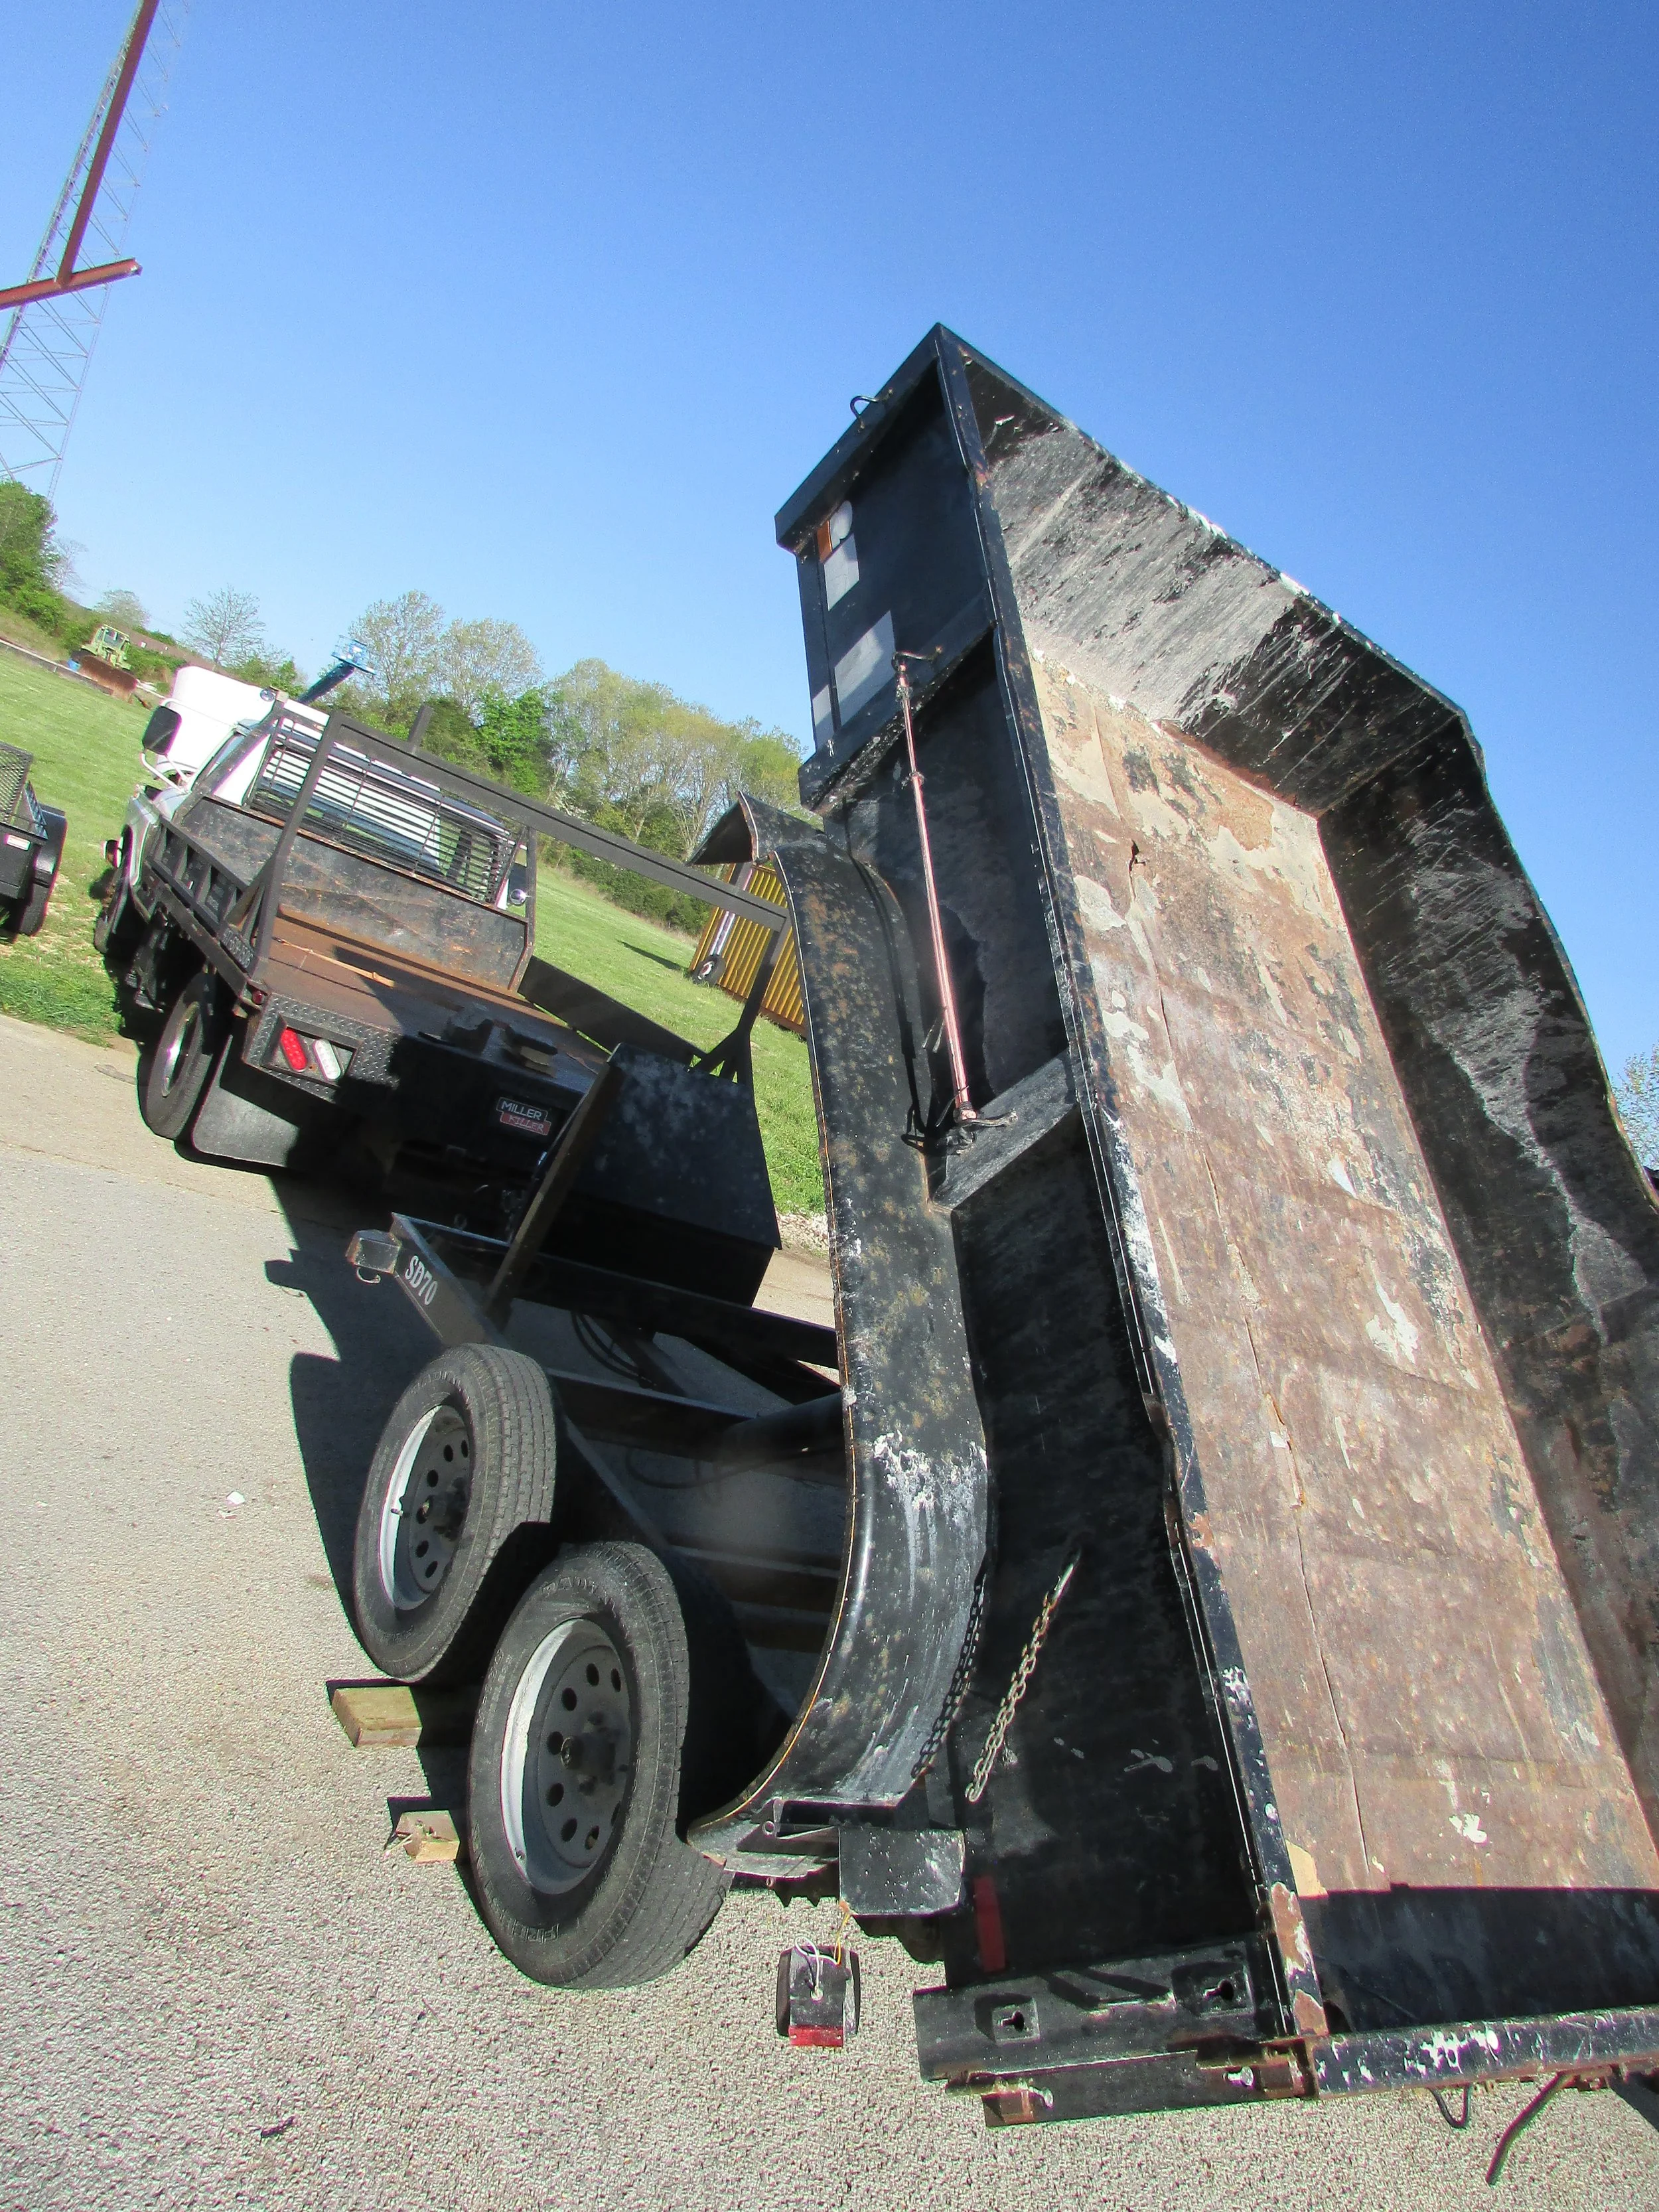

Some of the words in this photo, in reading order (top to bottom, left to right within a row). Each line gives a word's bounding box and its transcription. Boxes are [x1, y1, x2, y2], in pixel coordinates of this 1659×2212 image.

[501, 1101, 542, 1120] MILLER
[508, 1115, 544, 1134] KILLER
[404, 1255, 438, 1305] SD70
